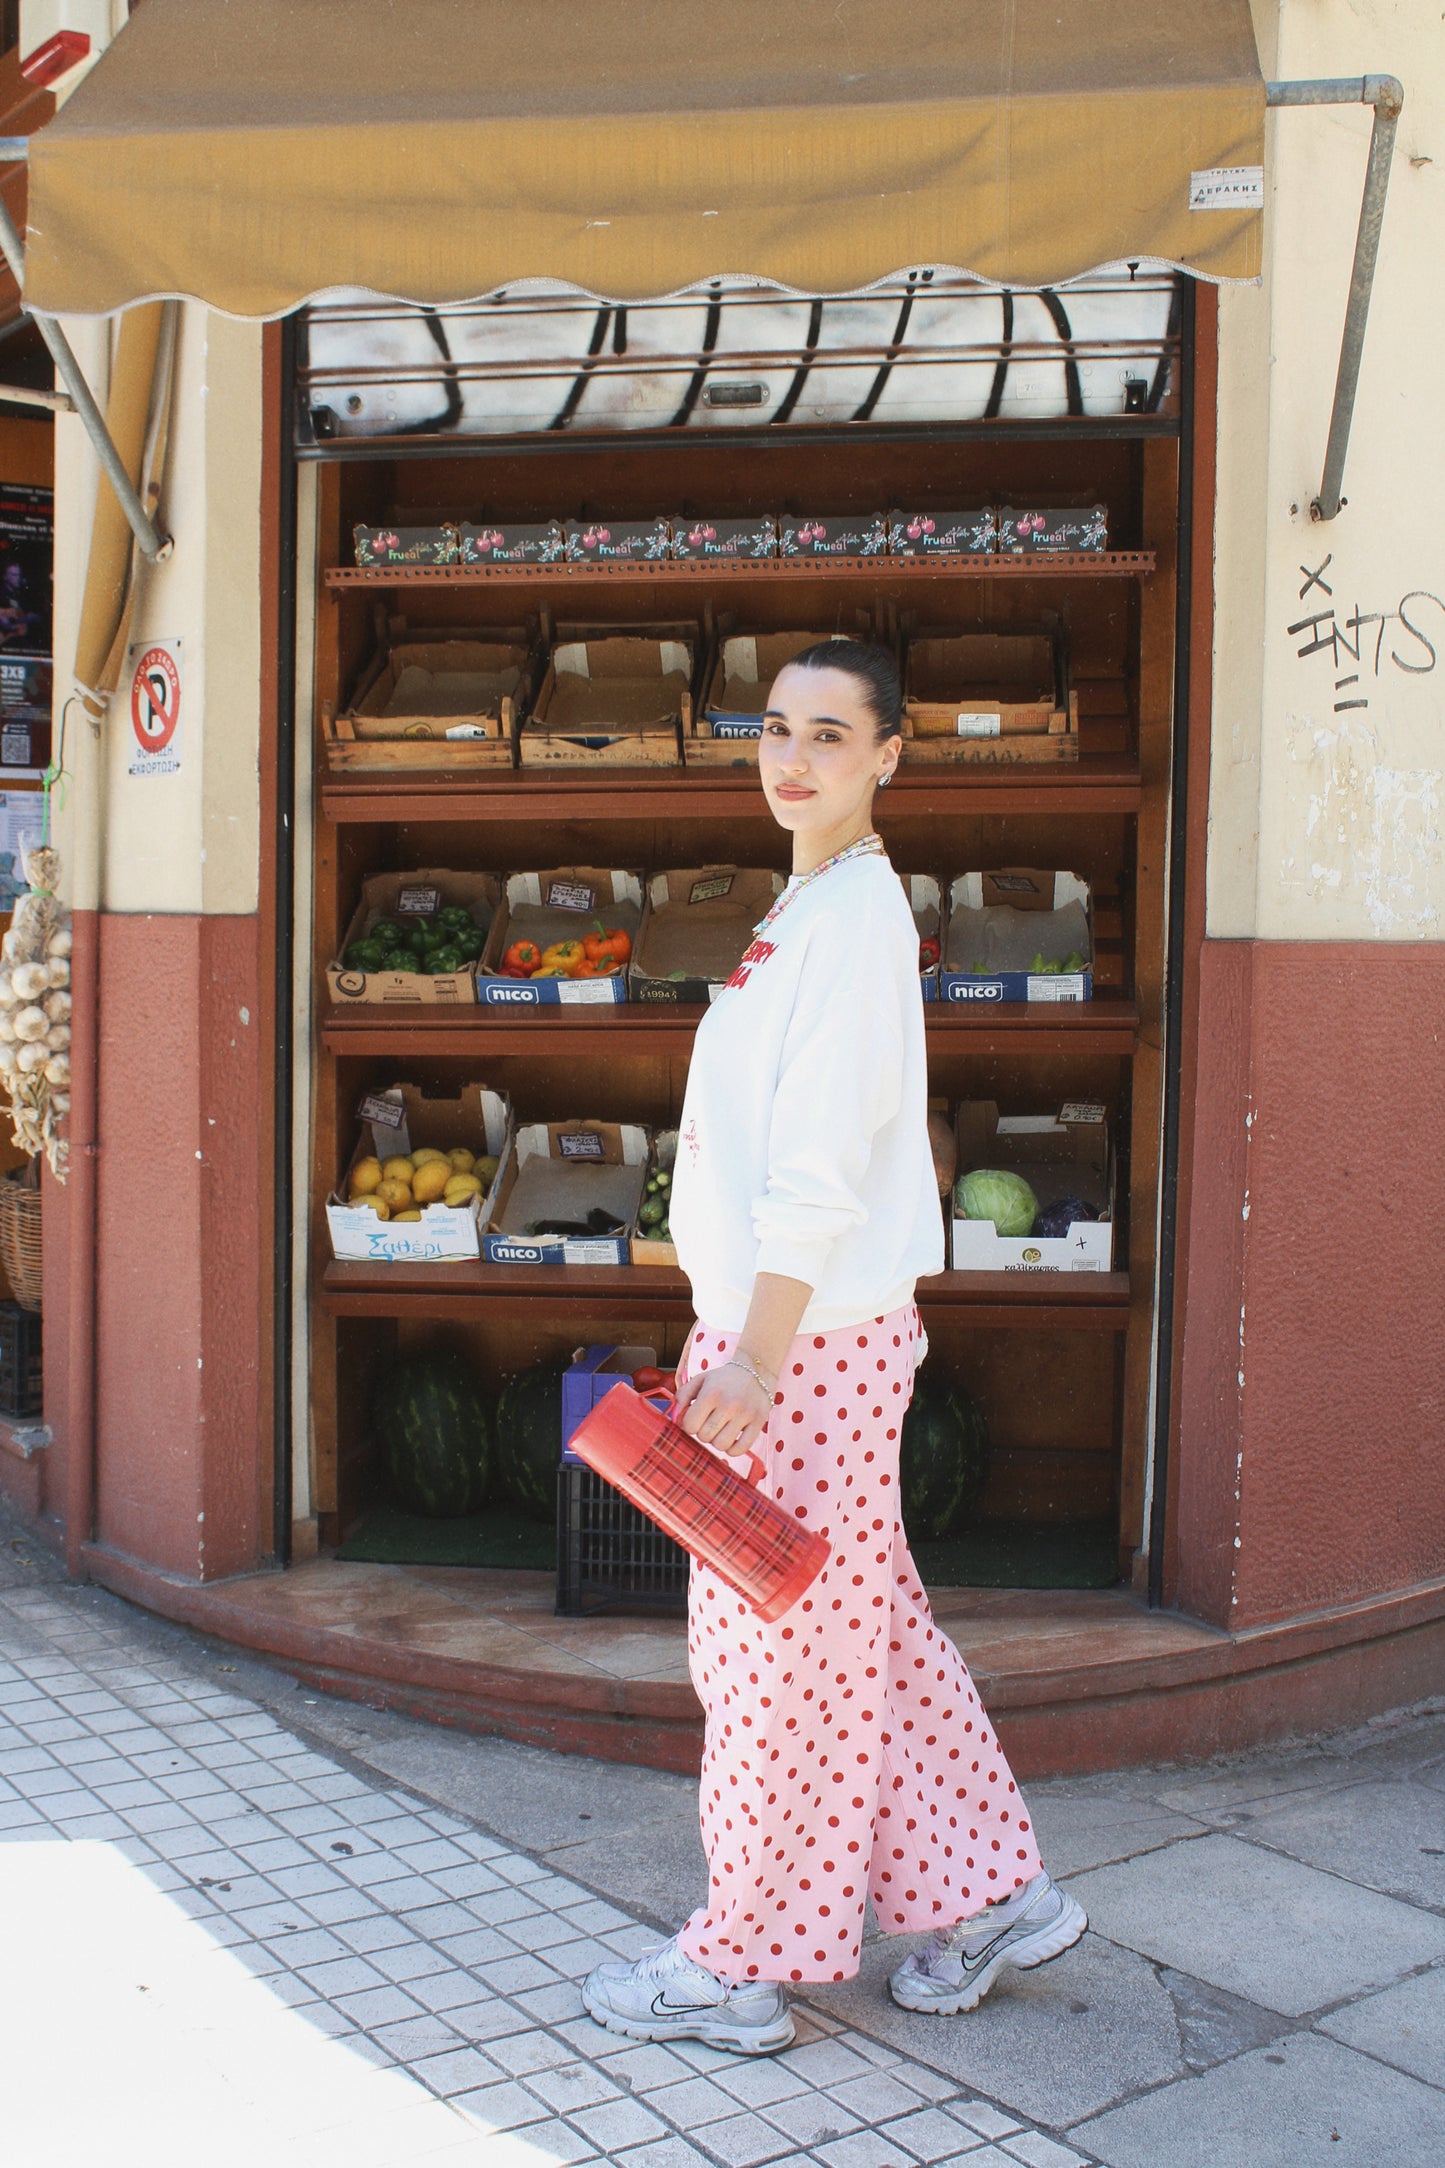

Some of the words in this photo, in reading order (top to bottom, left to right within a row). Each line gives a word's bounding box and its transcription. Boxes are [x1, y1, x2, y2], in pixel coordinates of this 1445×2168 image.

[492, 989, 534, 1001] nico
[955, 987, 998, 998] nico
[497, 1247, 538, 1259] nico
